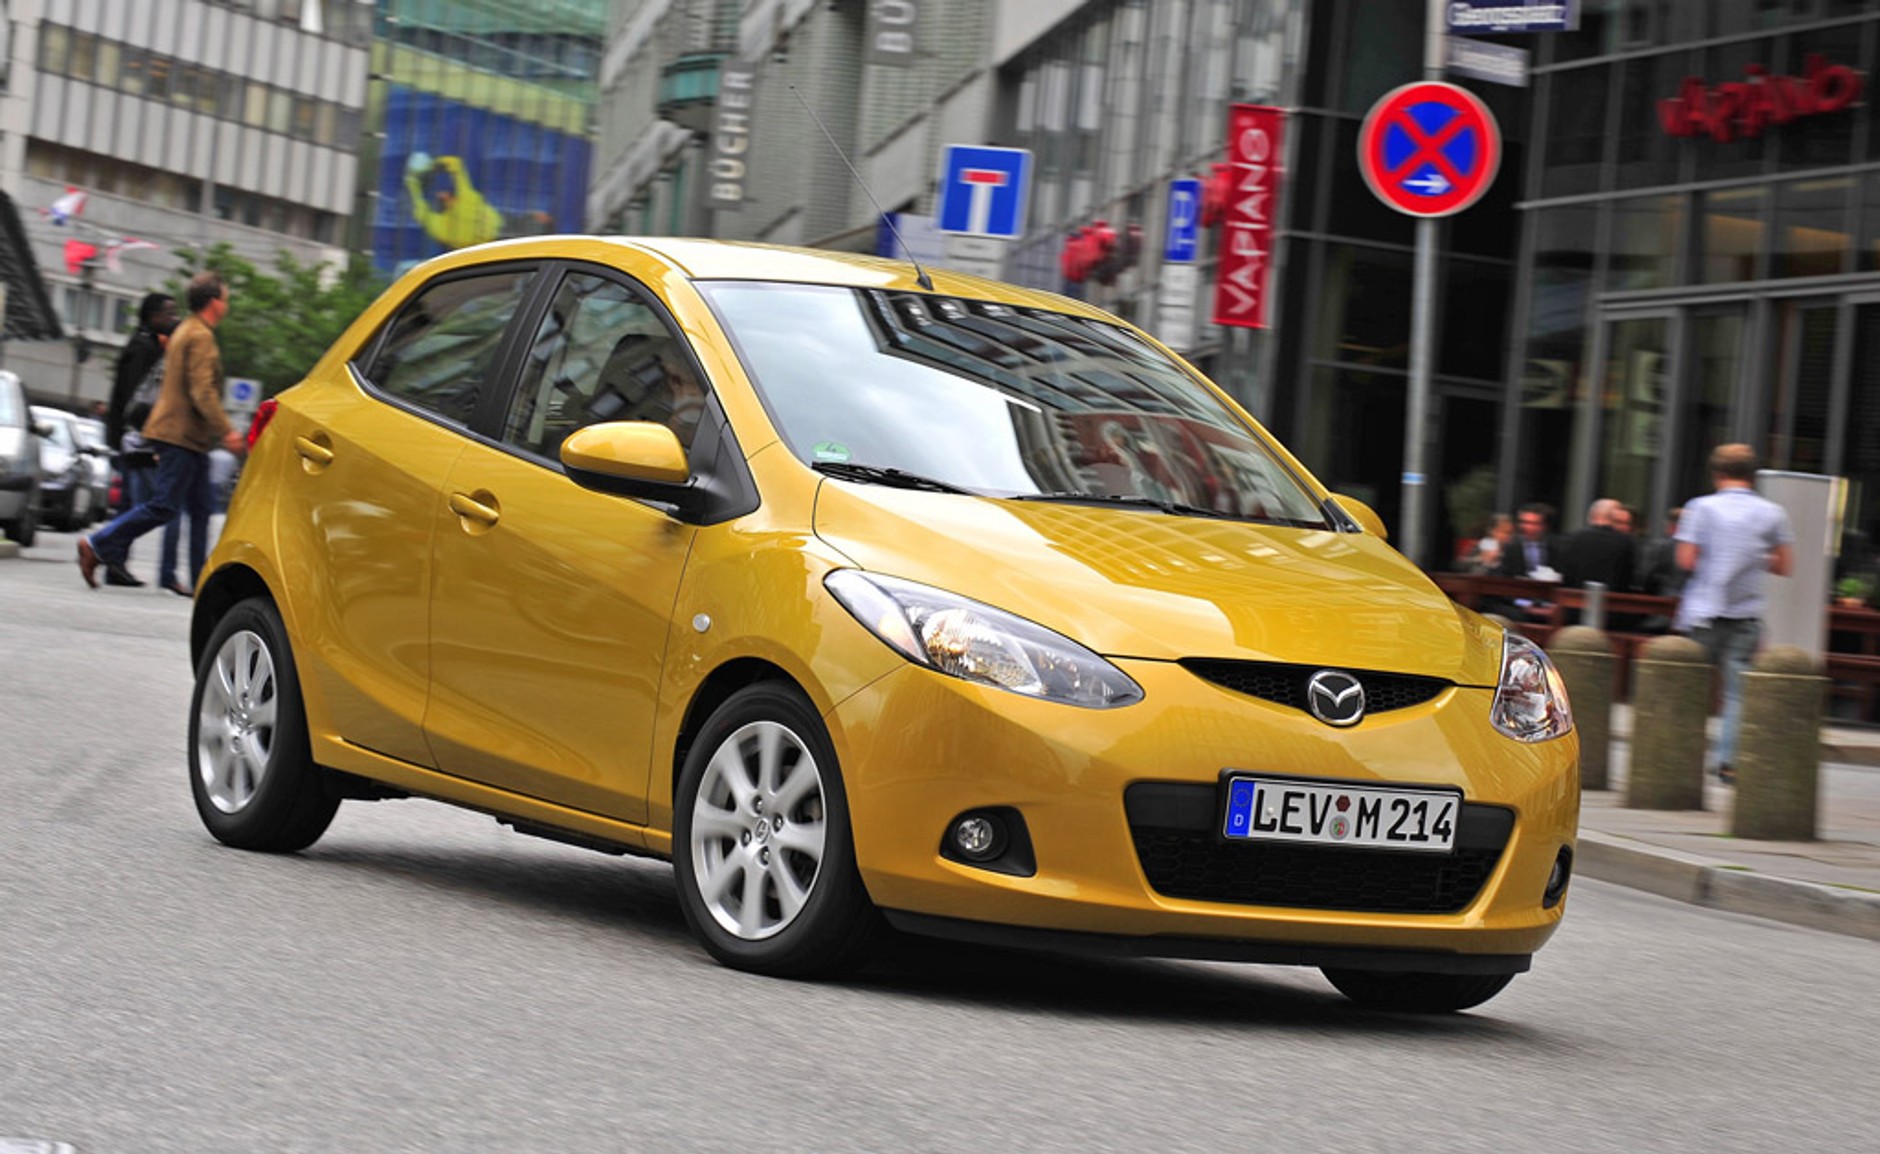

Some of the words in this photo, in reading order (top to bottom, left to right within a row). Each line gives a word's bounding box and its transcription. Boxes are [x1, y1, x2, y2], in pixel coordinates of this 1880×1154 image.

[708, 71, 752, 201] BÜCHER
[1220, 127, 1271, 314] VAPIANO
[1233, 814, 1244, 827] D
[1253, 789, 1333, 836] LEV
[1355, 797, 1382, 839] M
[1386, 798, 1453, 842] 214
